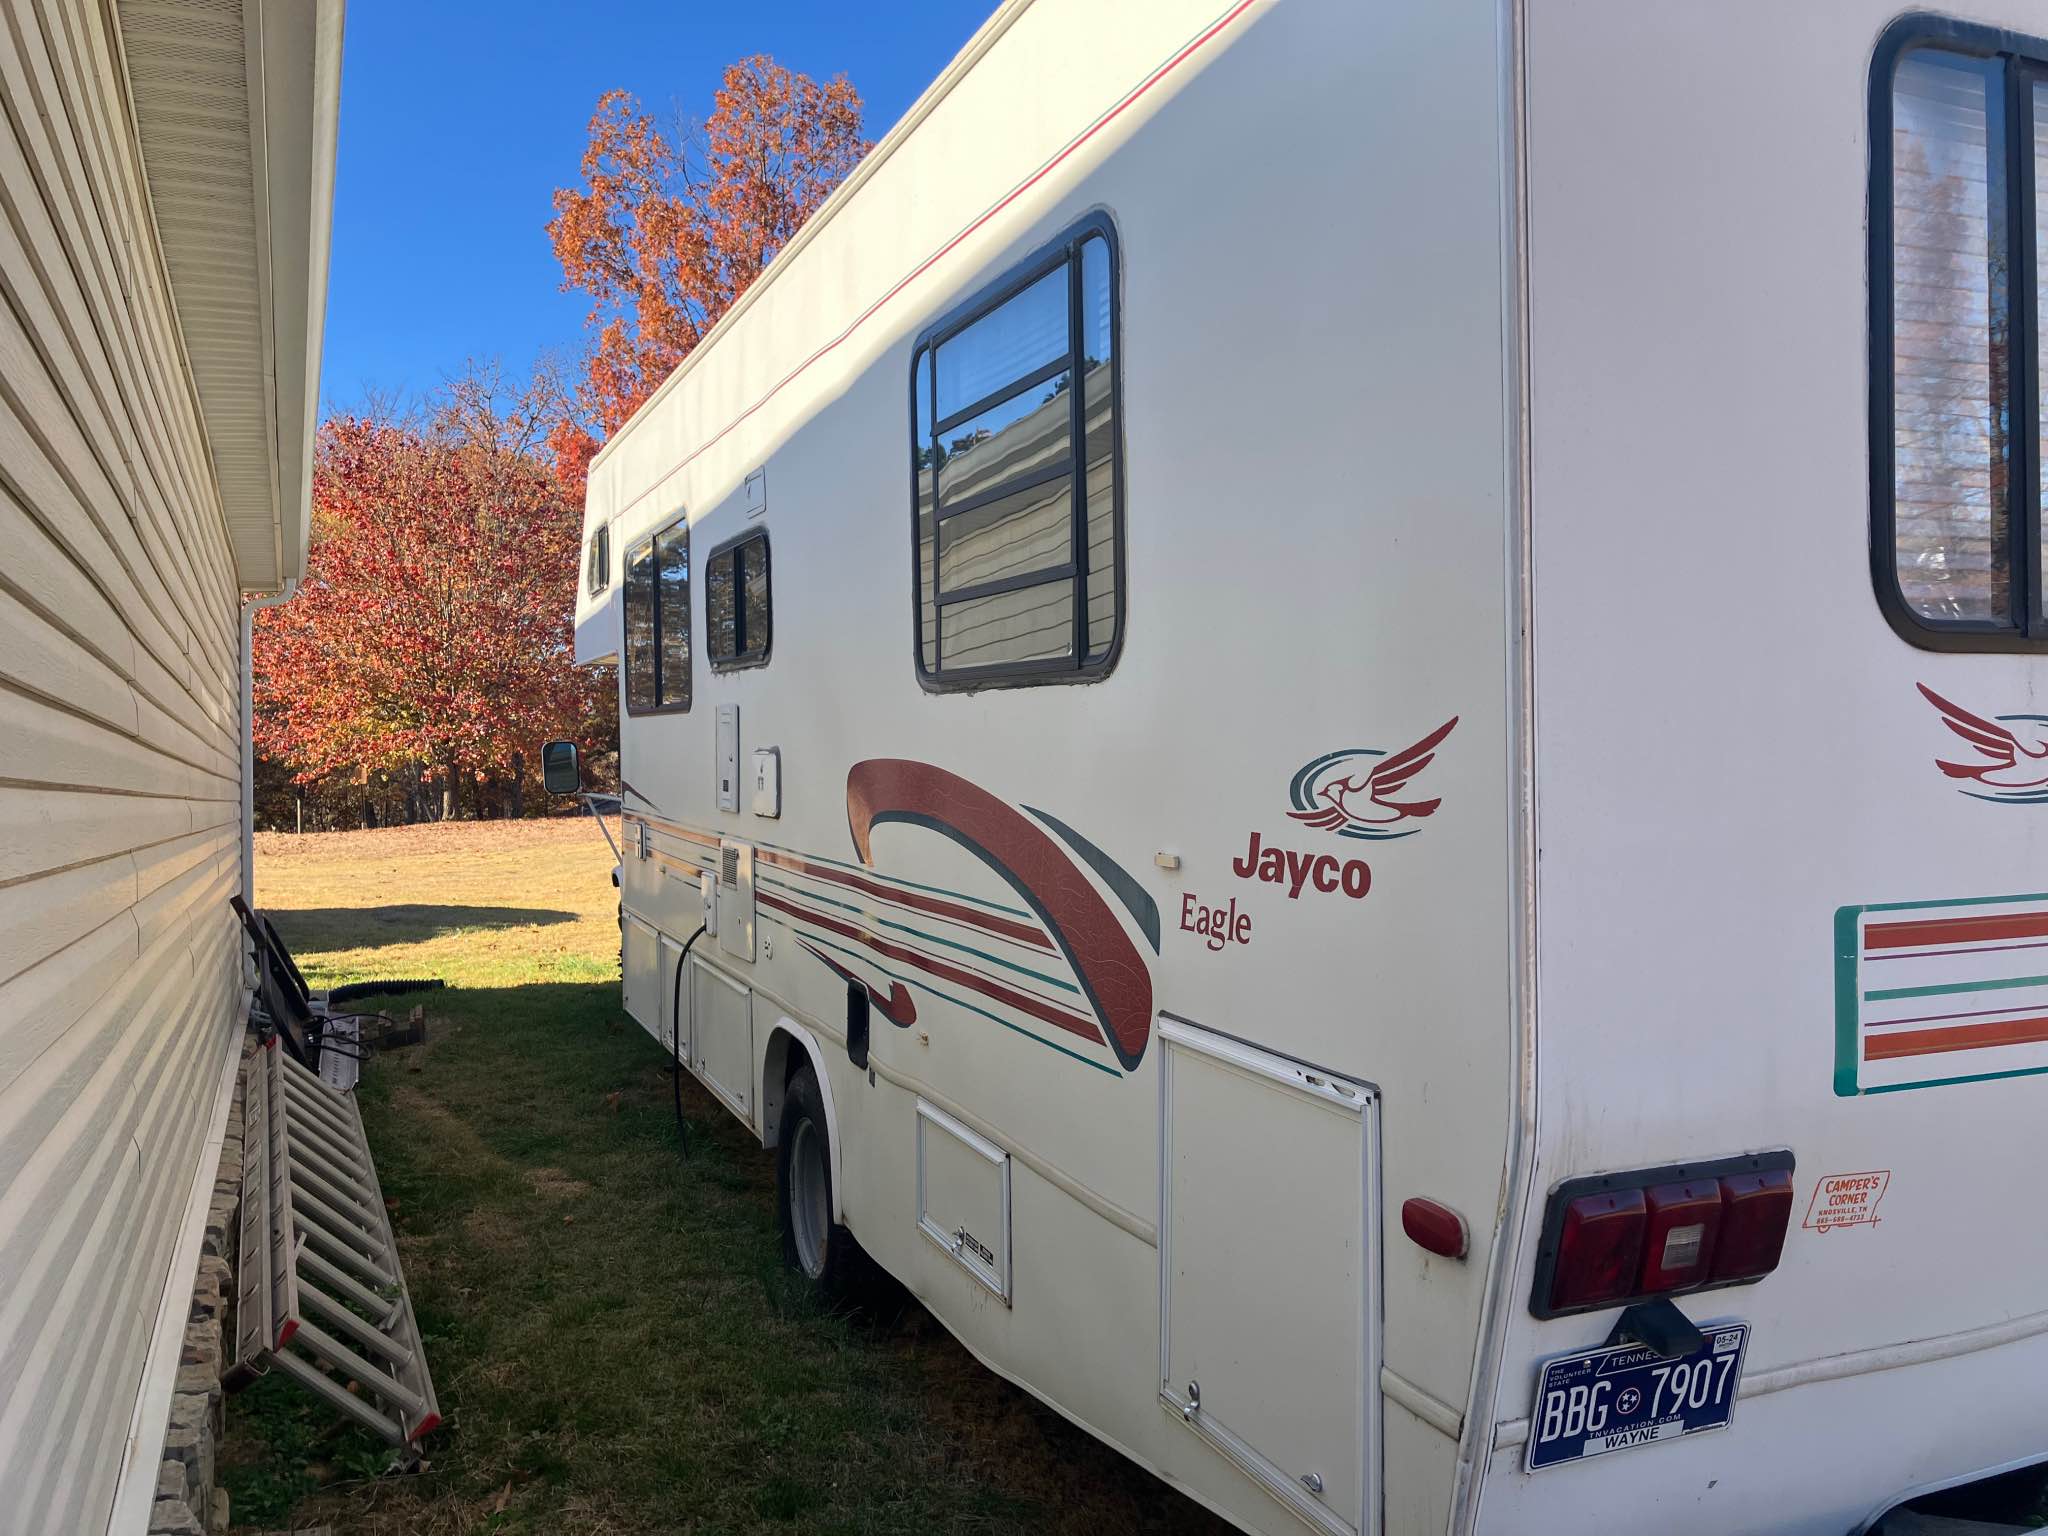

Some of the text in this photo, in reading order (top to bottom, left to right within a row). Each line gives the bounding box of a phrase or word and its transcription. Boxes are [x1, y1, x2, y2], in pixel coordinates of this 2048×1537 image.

[1233, 831, 1372, 899] Jayco
[1180, 892, 1252, 951] Eagle
[1826, 1176, 1879, 1193] CAMPER'S
[1829, 1192, 1867, 1206] CORNER
[1716, 1333, 1738, 1345] 05-24
[1611, 1350, 1660, 1368] TENNE
[1548, 1379, 1571, 1388] STATE
[1549, 1368, 1592, 1382] VOLUNTEER
[1540, 1353, 1736, 1443] BBG 7907
[1589, 1413, 1682, 1439] TNVACATION.COM
[1605, 1427, 1660, 1449] WAYNE
